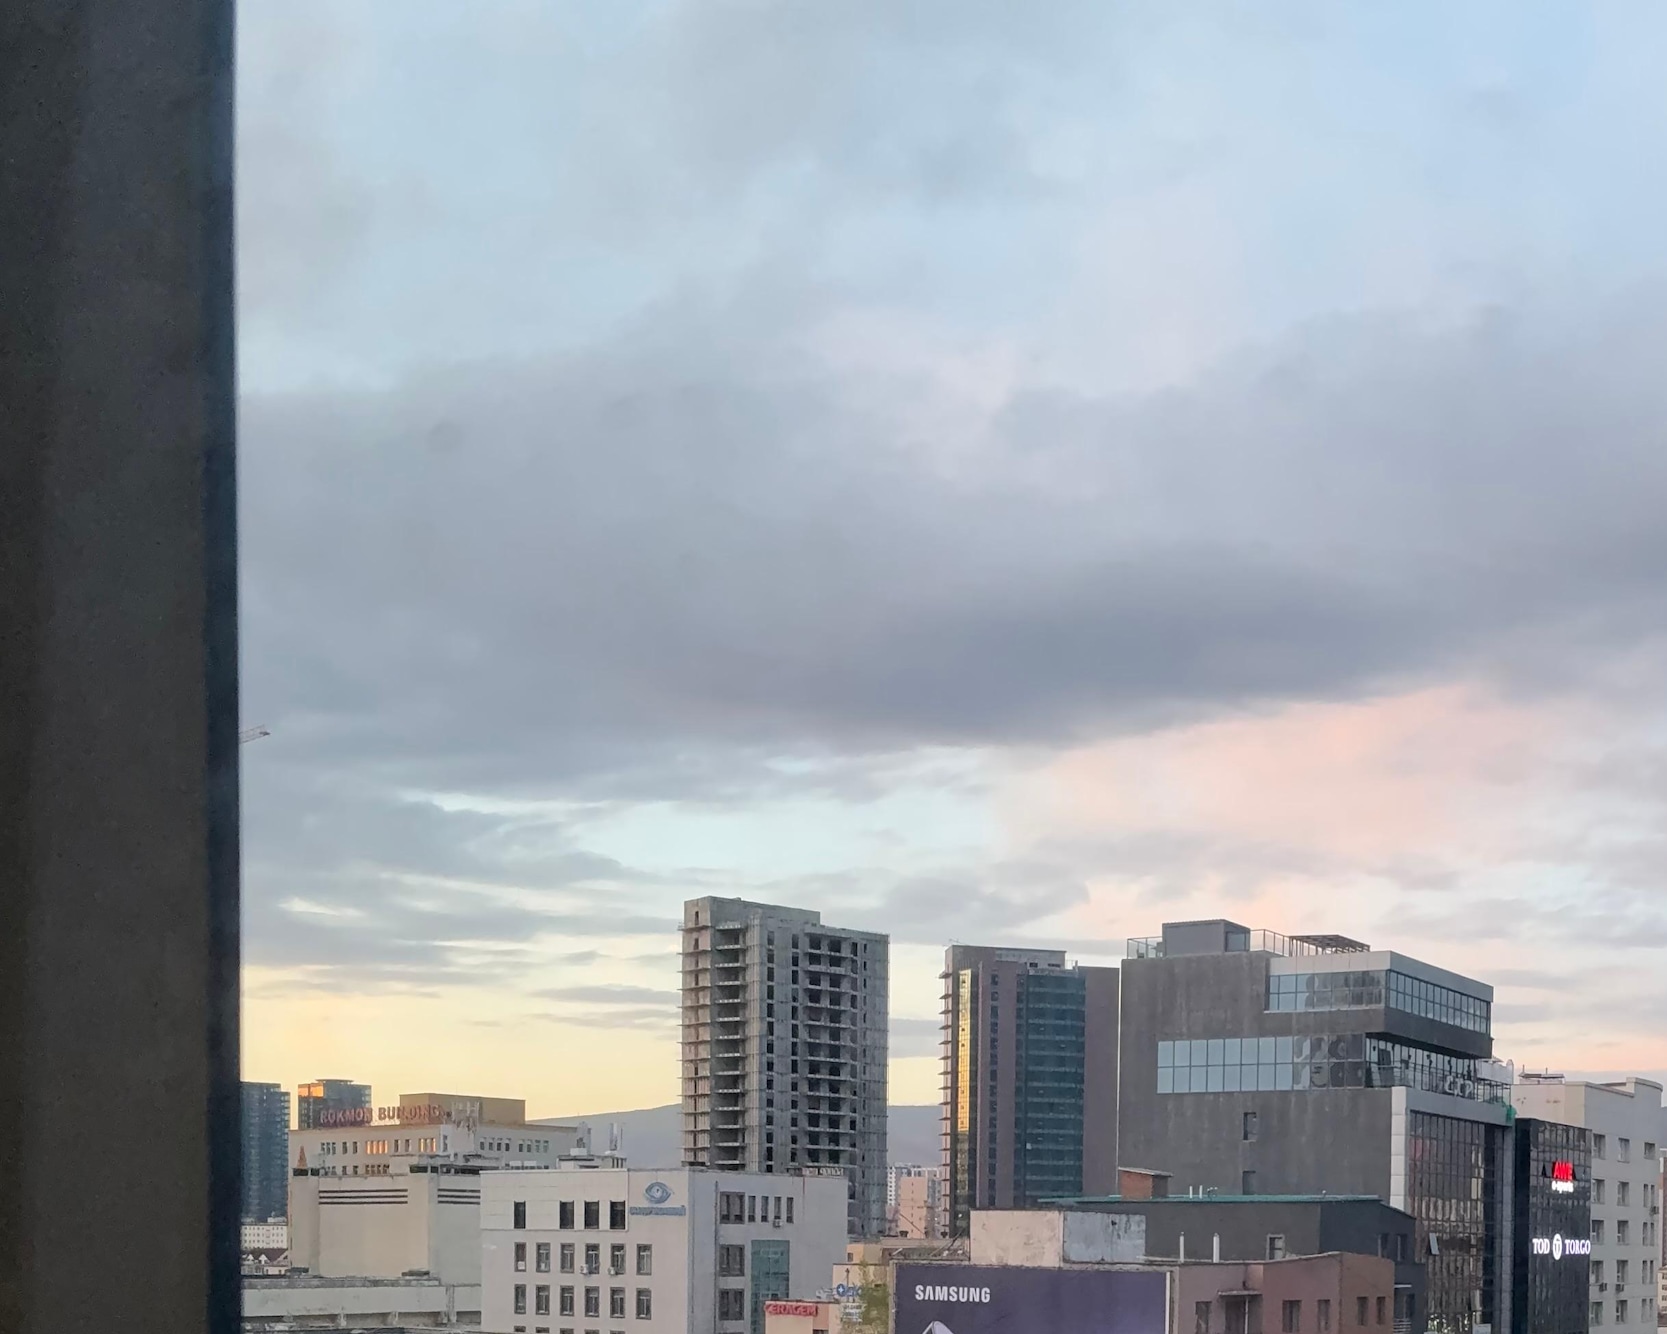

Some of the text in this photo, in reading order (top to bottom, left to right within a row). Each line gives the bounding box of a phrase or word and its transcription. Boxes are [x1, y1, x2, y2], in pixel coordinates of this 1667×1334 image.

[1532, 1238, 1550, 1254] TOD
[1565, 1240, 1591, 1254] TORGO
[915, 1284, 991, 1303] SAMSUNG
